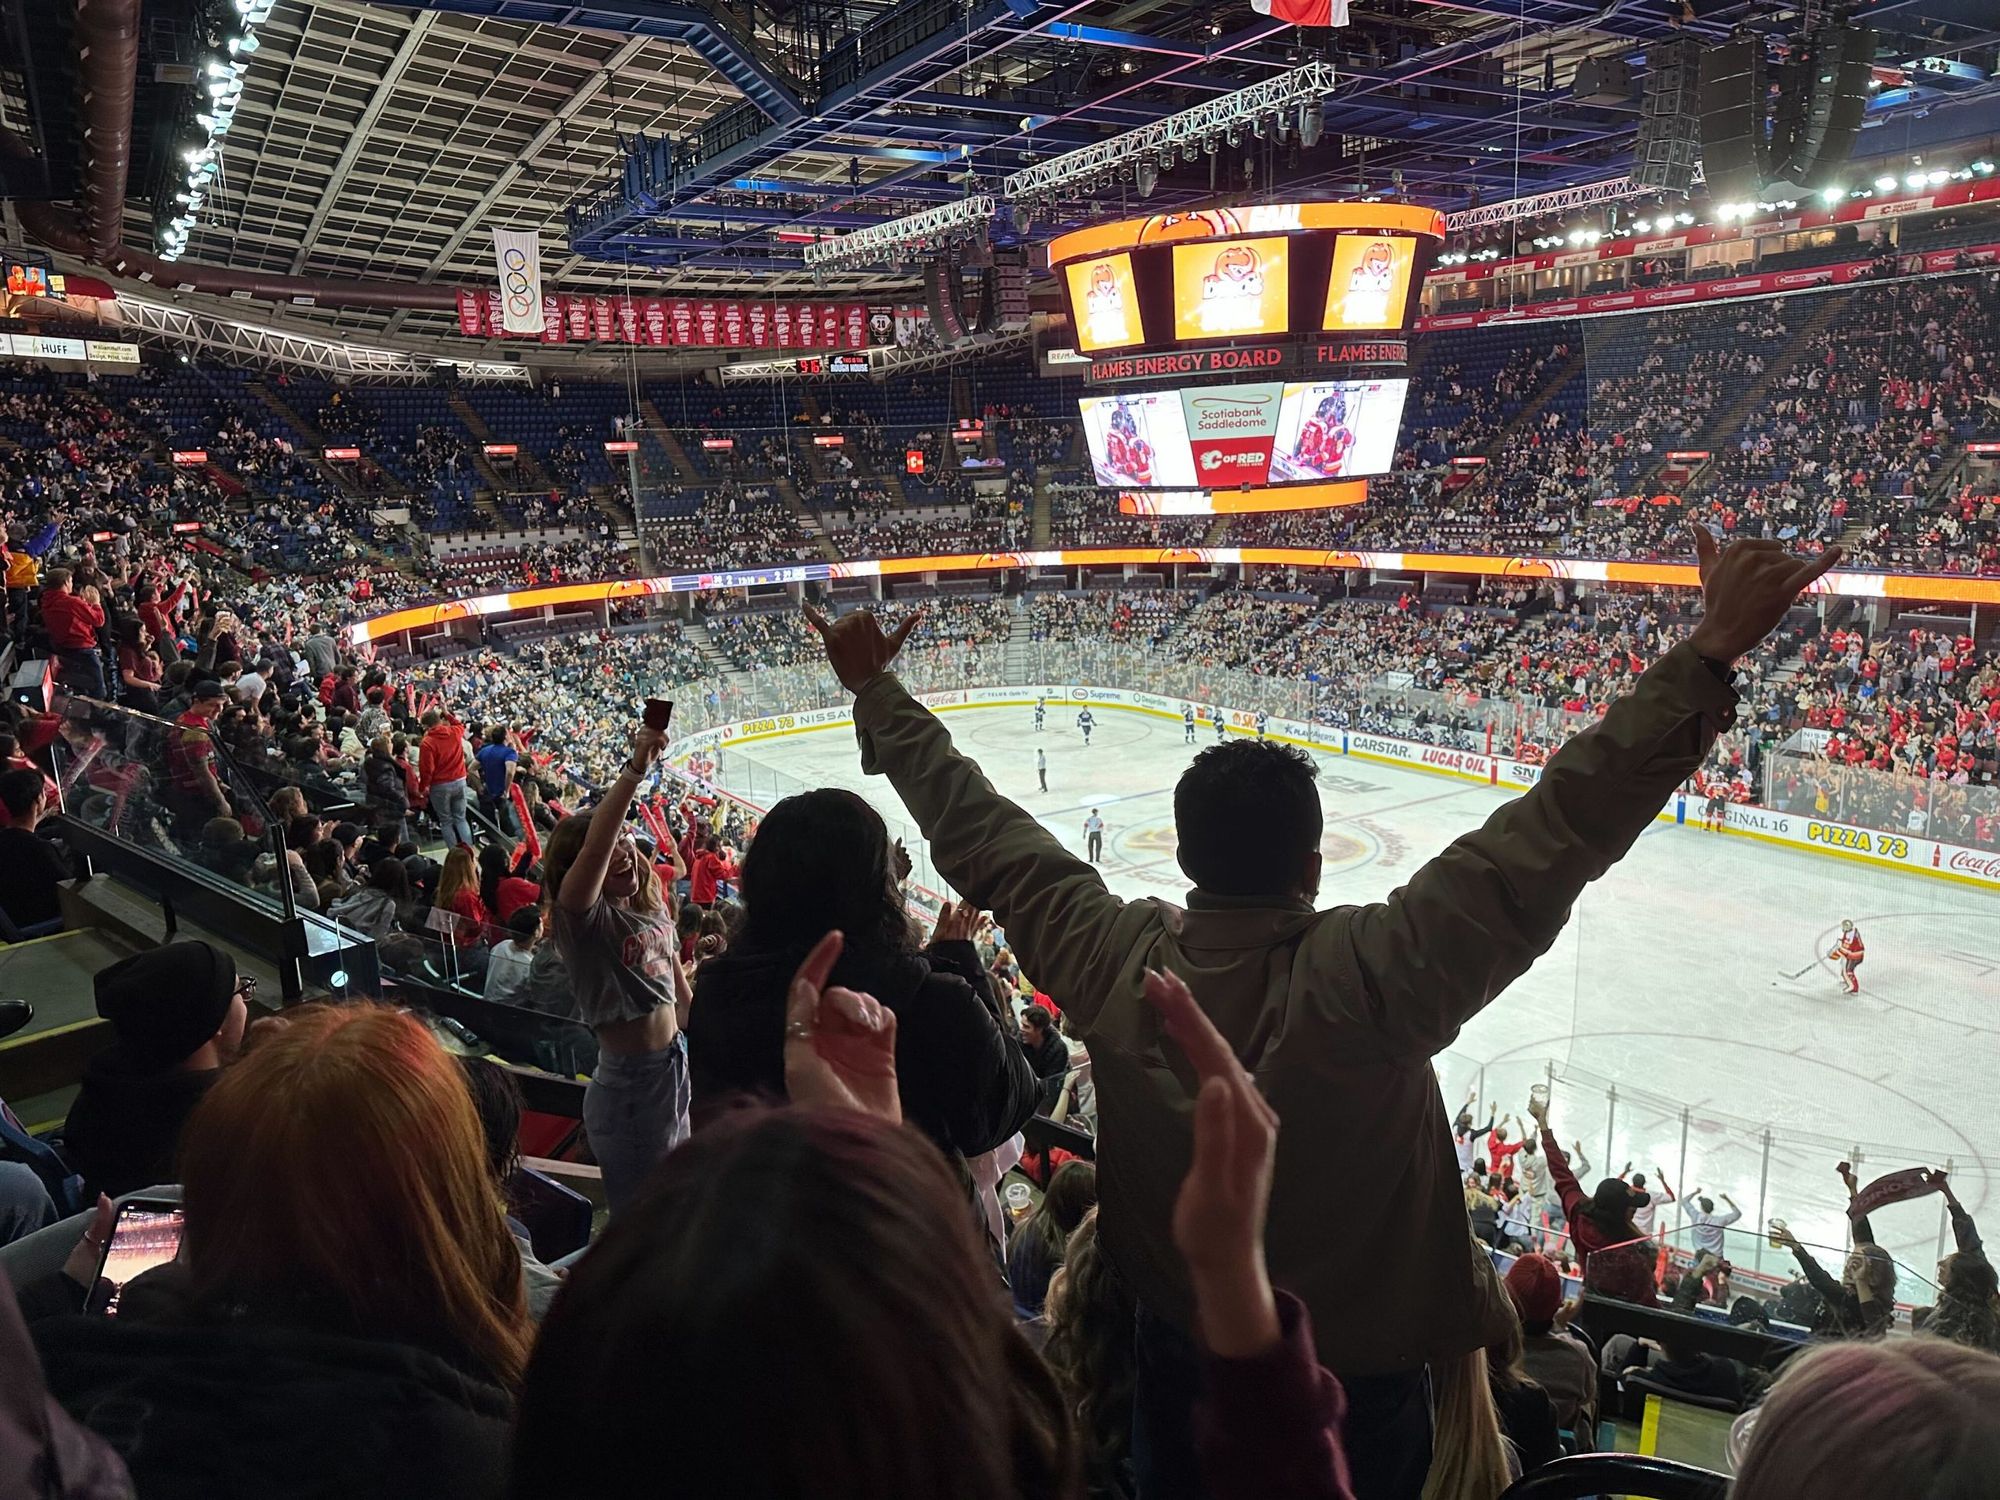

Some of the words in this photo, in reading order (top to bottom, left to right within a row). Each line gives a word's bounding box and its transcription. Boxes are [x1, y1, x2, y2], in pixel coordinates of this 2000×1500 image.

[41, 343, 68, 355] HUFF
[1318, 344, 1377, 362] FLAMES
[1051, 352, 1076, 360] RE/MA
[1092, 360, 1133, 380] FLAMES
[1135, 353, 1204, 375] ENERGY
[1210, 349, 1282, 369] BOARD
[1201, 406, 1263, 419] Scotiabank
[1198, 418, 1267, 430] Saddledome
[1237, 452, 1266, 464] RED
[1090, 689, 1121, 701] Supreme
[742, 719, 776, 736] PIZZA
[777, 716, 795, 729] 73
[1804, 731, 1827, 740] NISS
[1421, 748, 1463, 769] LUCAS
[1465, 756, 1486, 773] OIL
[1697, 805, 1769, 829] OGINAL
[1772, 819, 1789, 833] 16
[1808, 821, 1872, 851] PIZZA
[1877, 835, 1909, 858] 73
